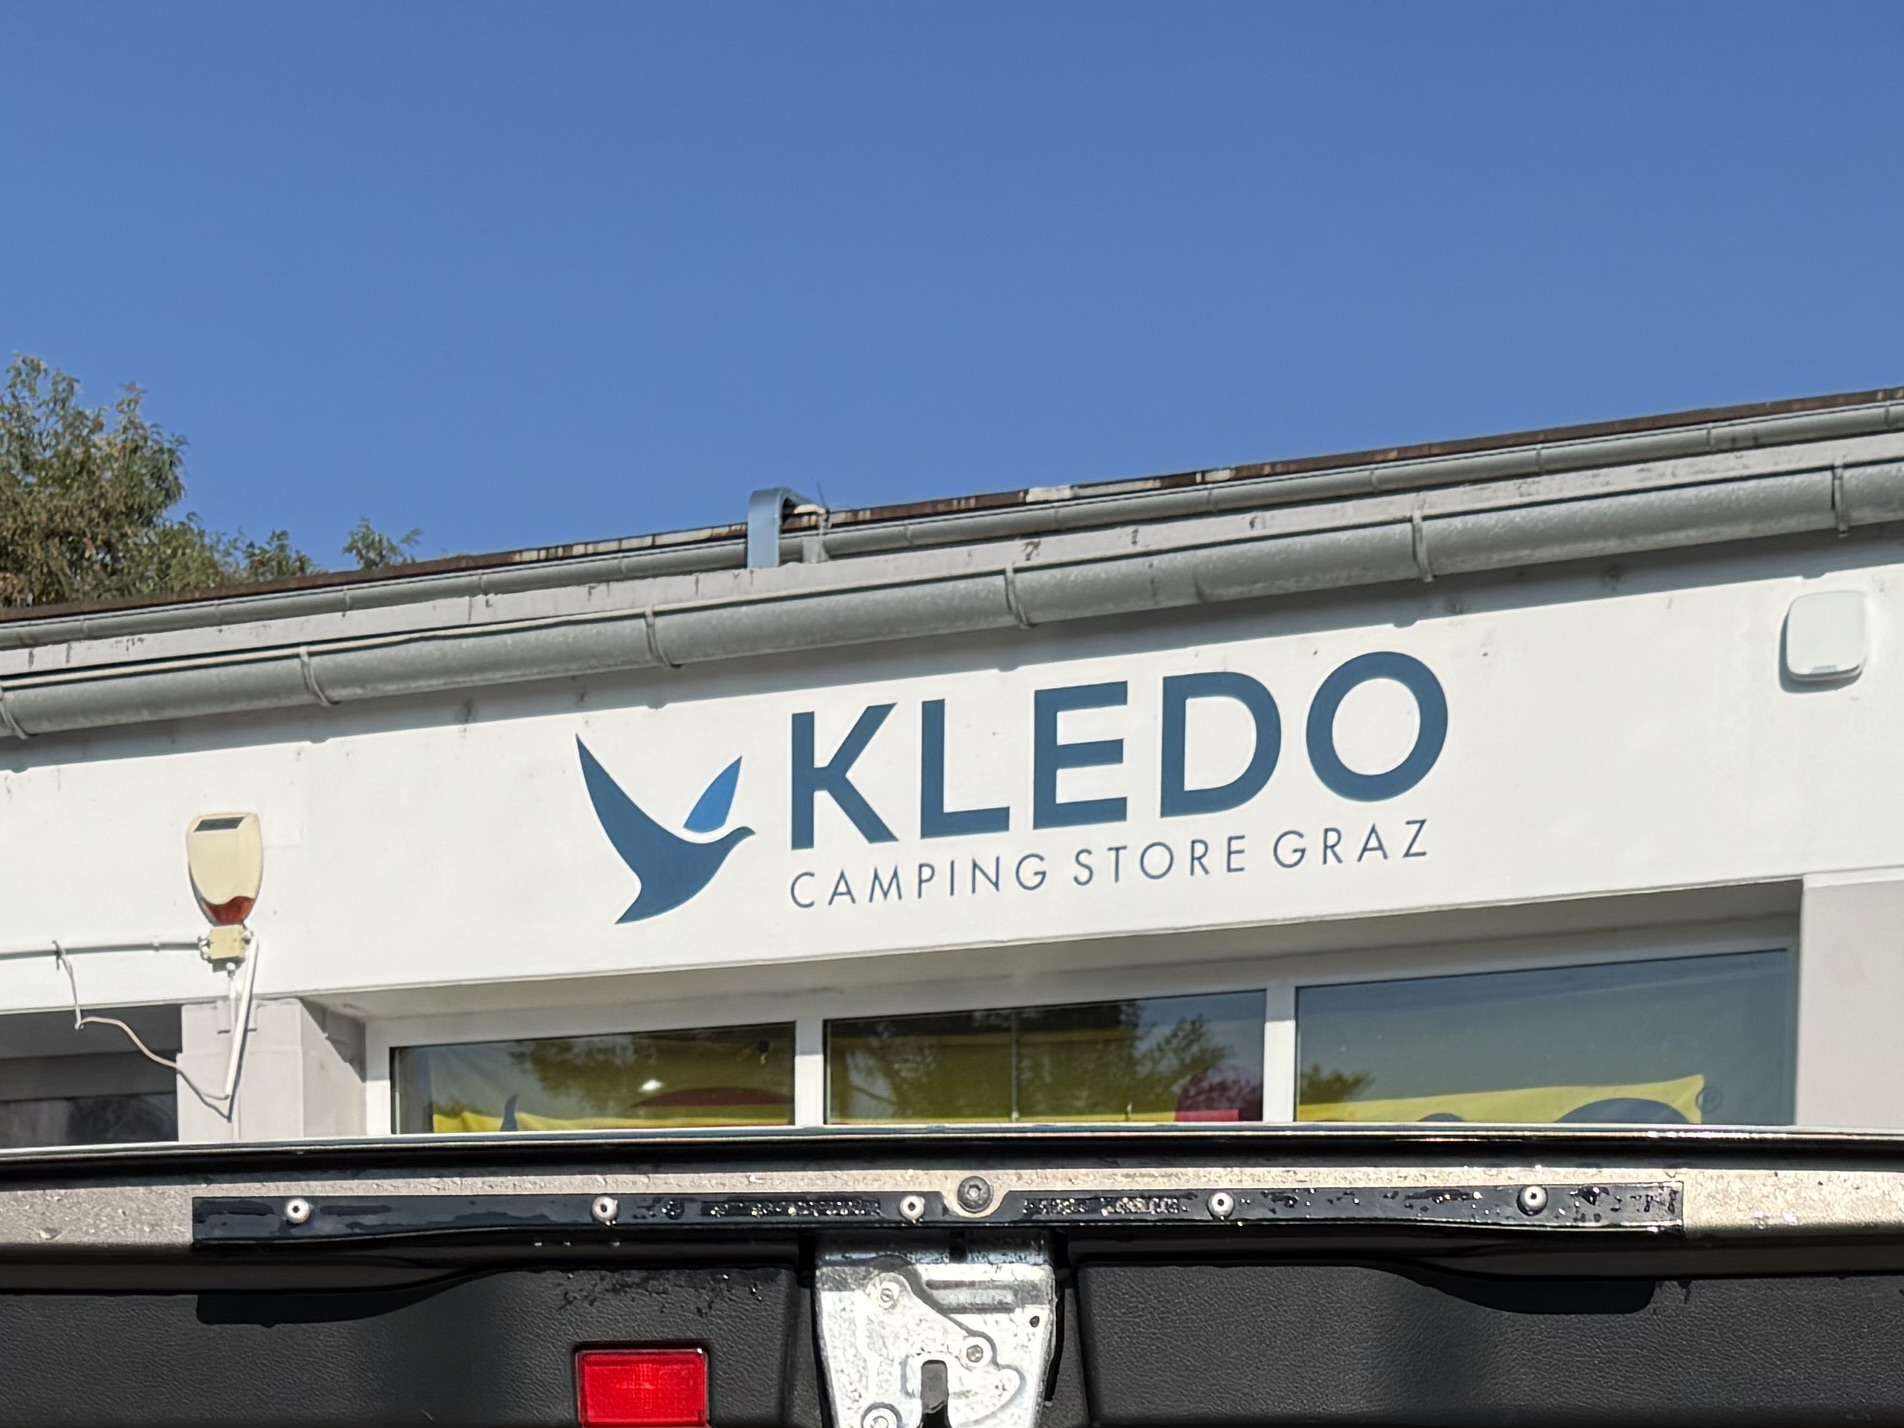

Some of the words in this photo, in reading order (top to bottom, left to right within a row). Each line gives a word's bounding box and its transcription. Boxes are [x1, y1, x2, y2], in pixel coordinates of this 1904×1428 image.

[791, 651, 1448, 850] KLEDO
[790, 853, 1047, 908] CAMPING
[1072, 834, 1246, 886] STORE
[1272, 819, 1427, 868] GRAZ
